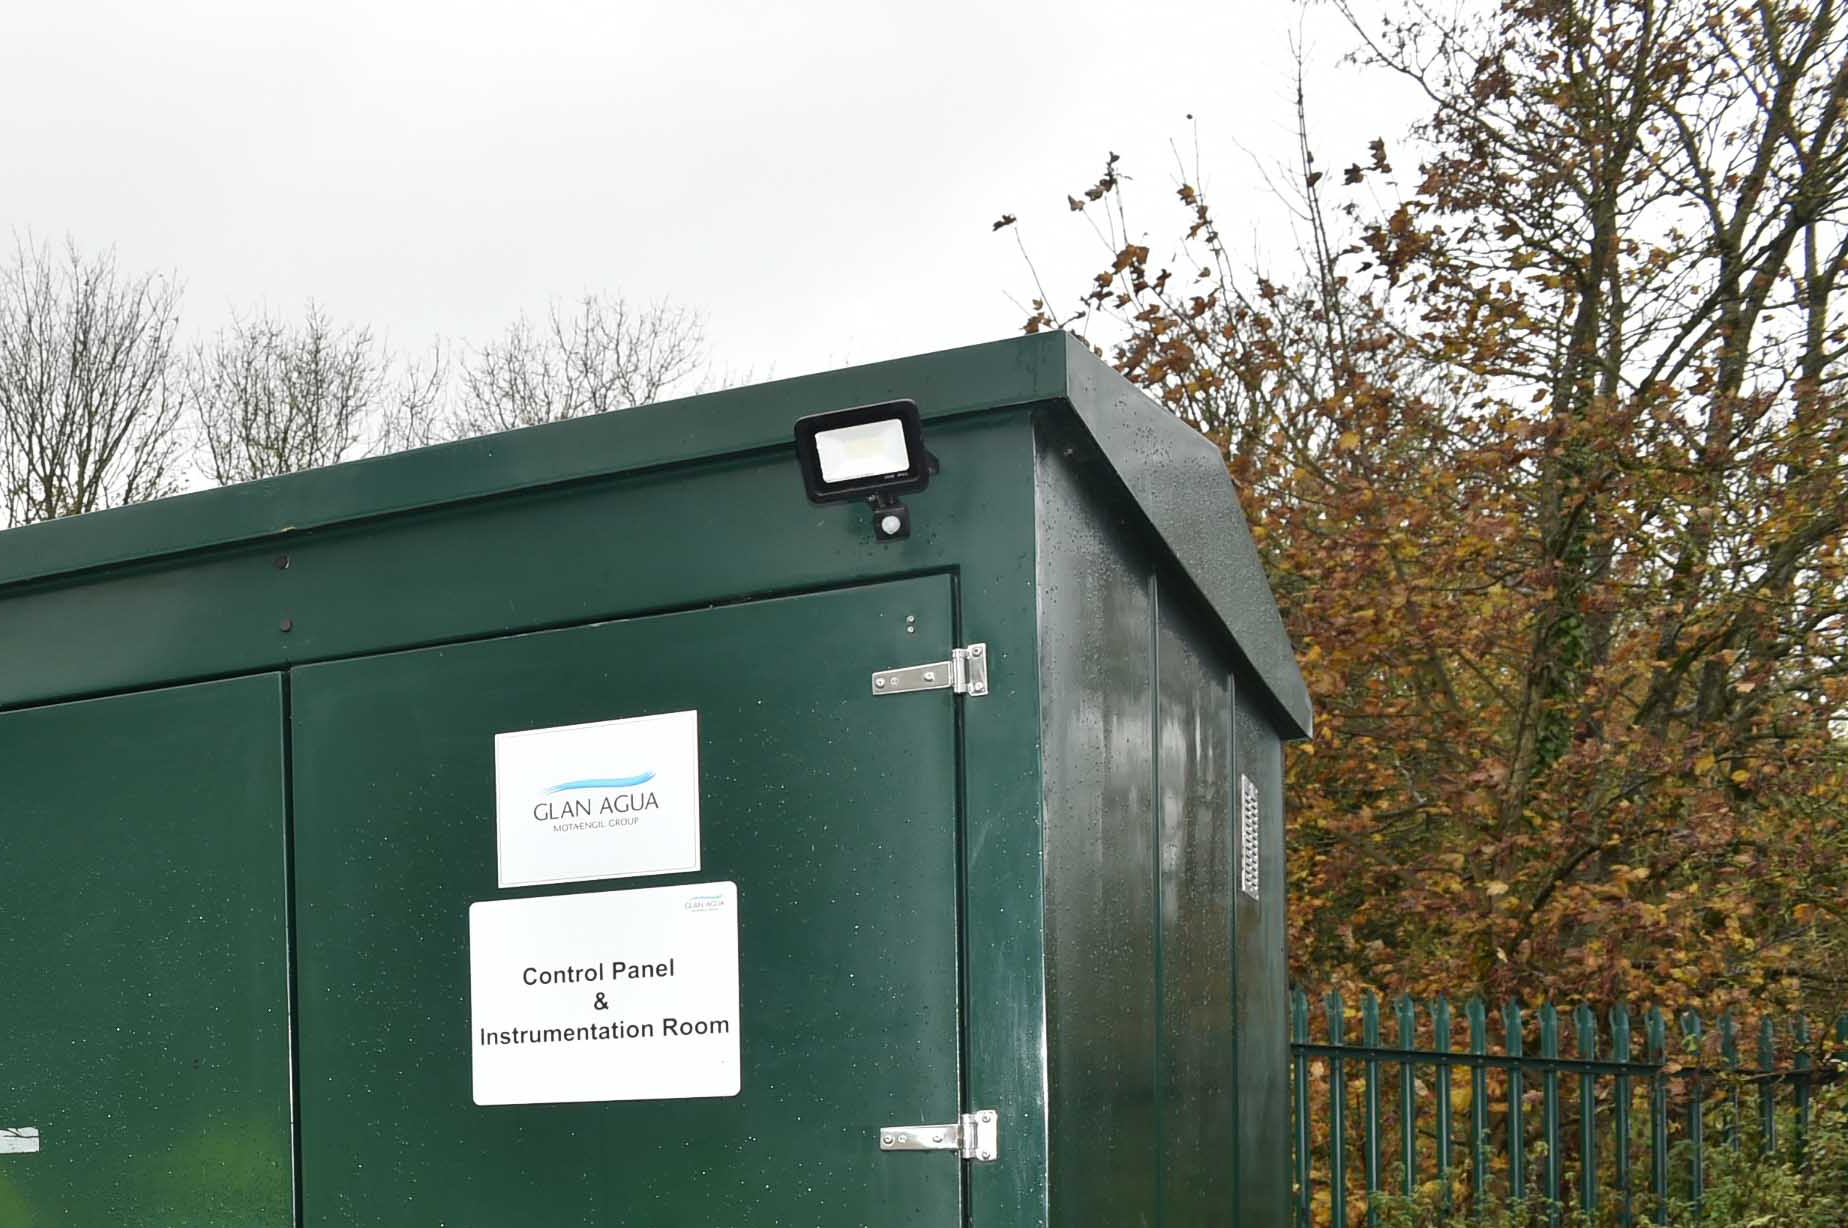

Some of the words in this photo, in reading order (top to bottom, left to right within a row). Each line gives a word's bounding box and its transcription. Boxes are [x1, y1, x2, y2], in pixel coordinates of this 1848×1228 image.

[533, 798, 591, 821] GLAN
[599, 792, 659, 815] AGUA
[608, 817, 639, 828] GROUP
[523, 963, 604, 985] Control
[612, 958, 674, 980] Panel
[594, 992, 609, 1010] &
[480, 1021, 654, 1046] Instrumentation
[663, 1018, 730, 1037] Room
